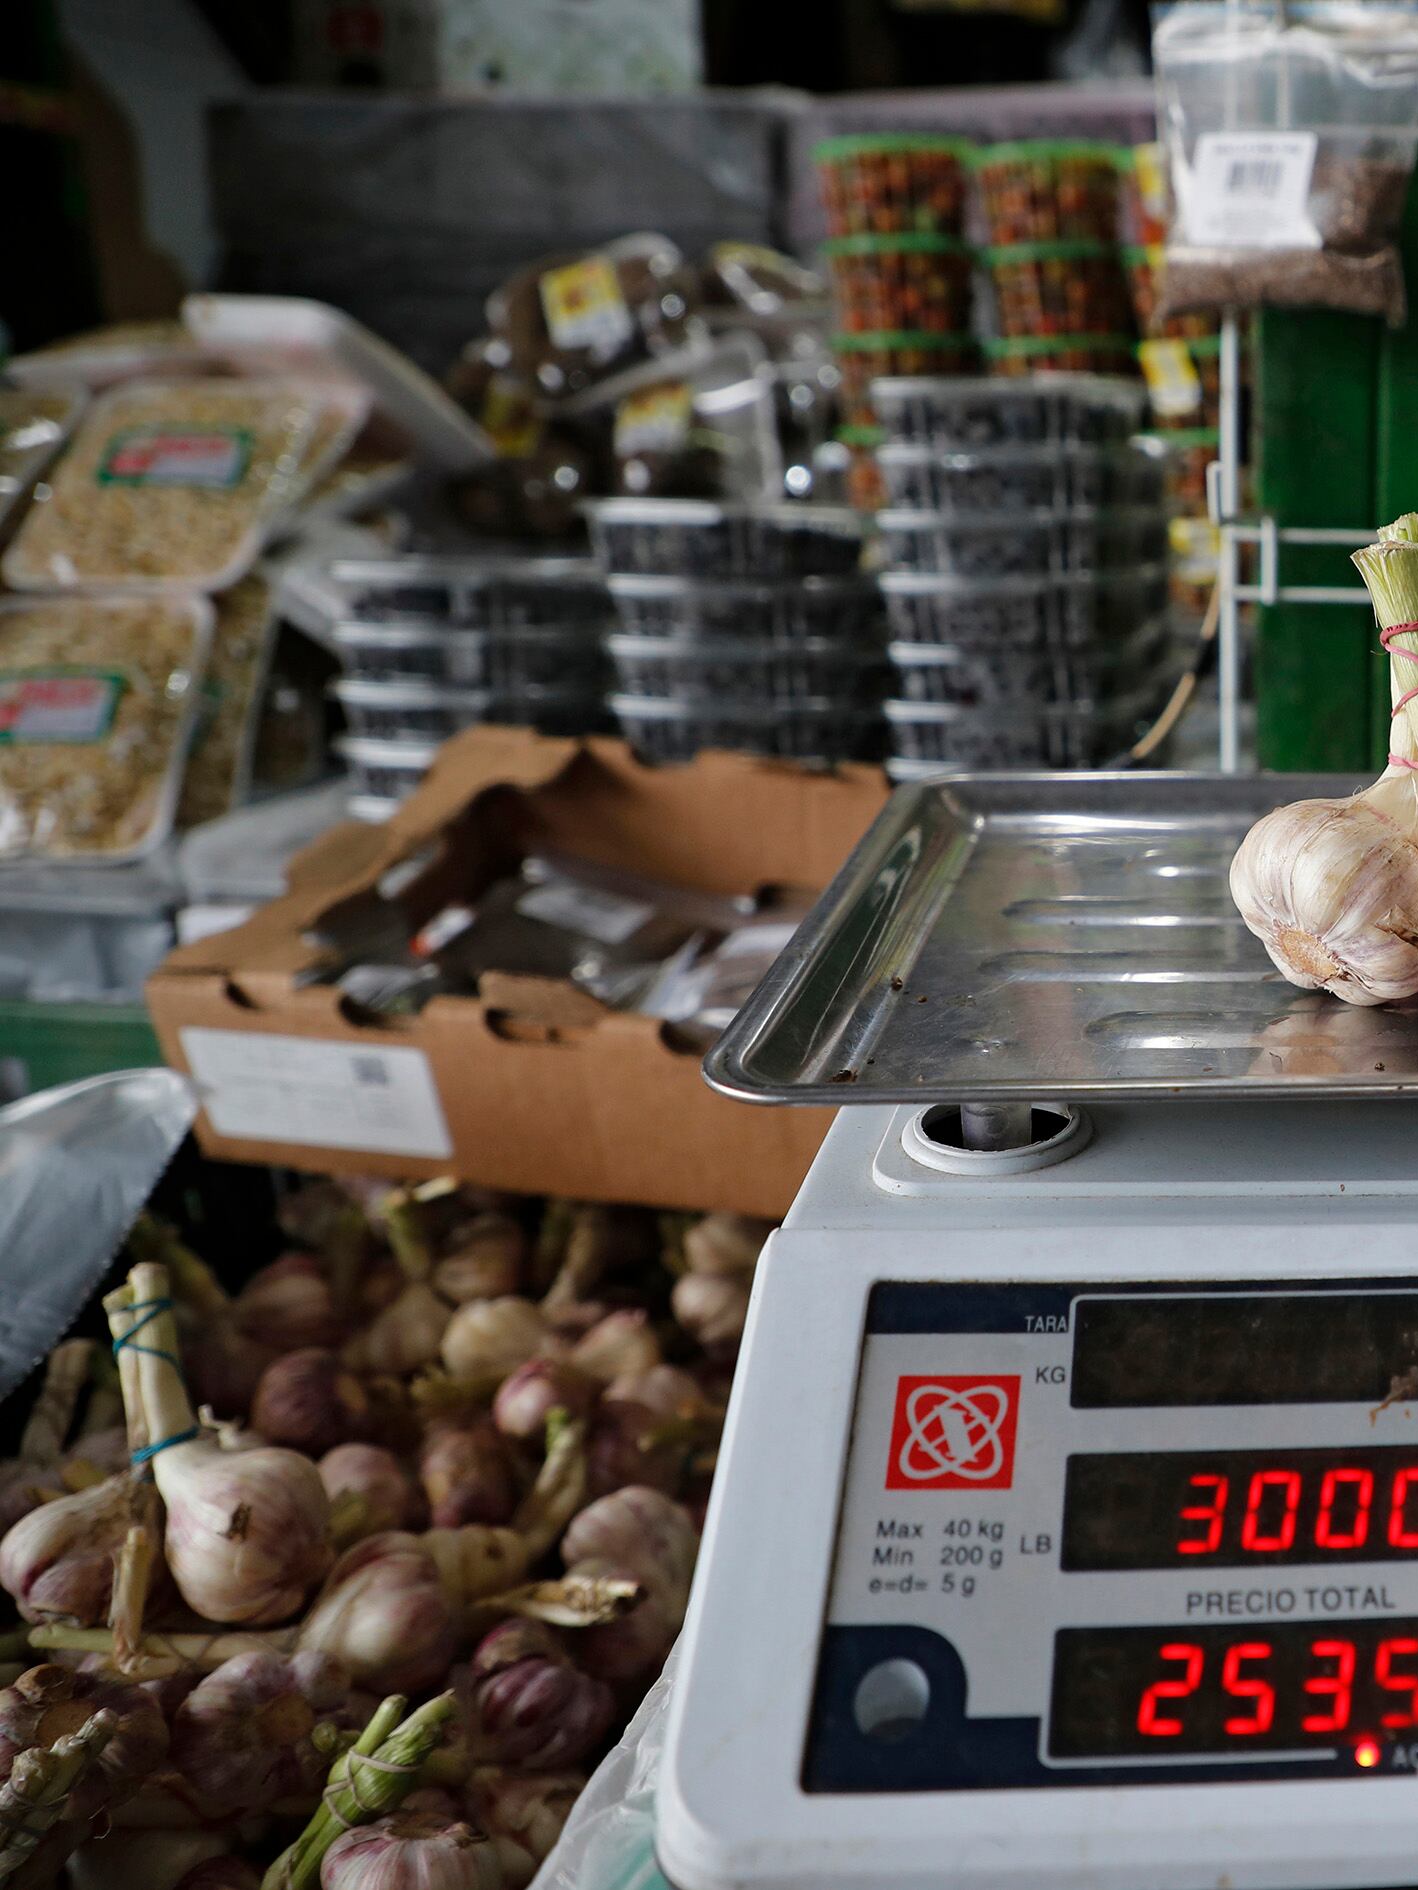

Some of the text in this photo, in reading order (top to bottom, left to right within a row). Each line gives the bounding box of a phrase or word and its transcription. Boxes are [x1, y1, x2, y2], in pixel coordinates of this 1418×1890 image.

[1024, 1315, 1068, 1333] TARA
[1035, 1366, 1066, 1384] KG
[876, 1519, 1004, 1542] Max 40 kg
[1020, 1534, 1051, 1554] LB
[872, 1546, 1003, 1569] Min 200 g
[941, 1573, 955, 1593] 5
[962, 1577, 975, 1597] g
[1186, 1583, 1396, 1616] PRECIO TOTAL
